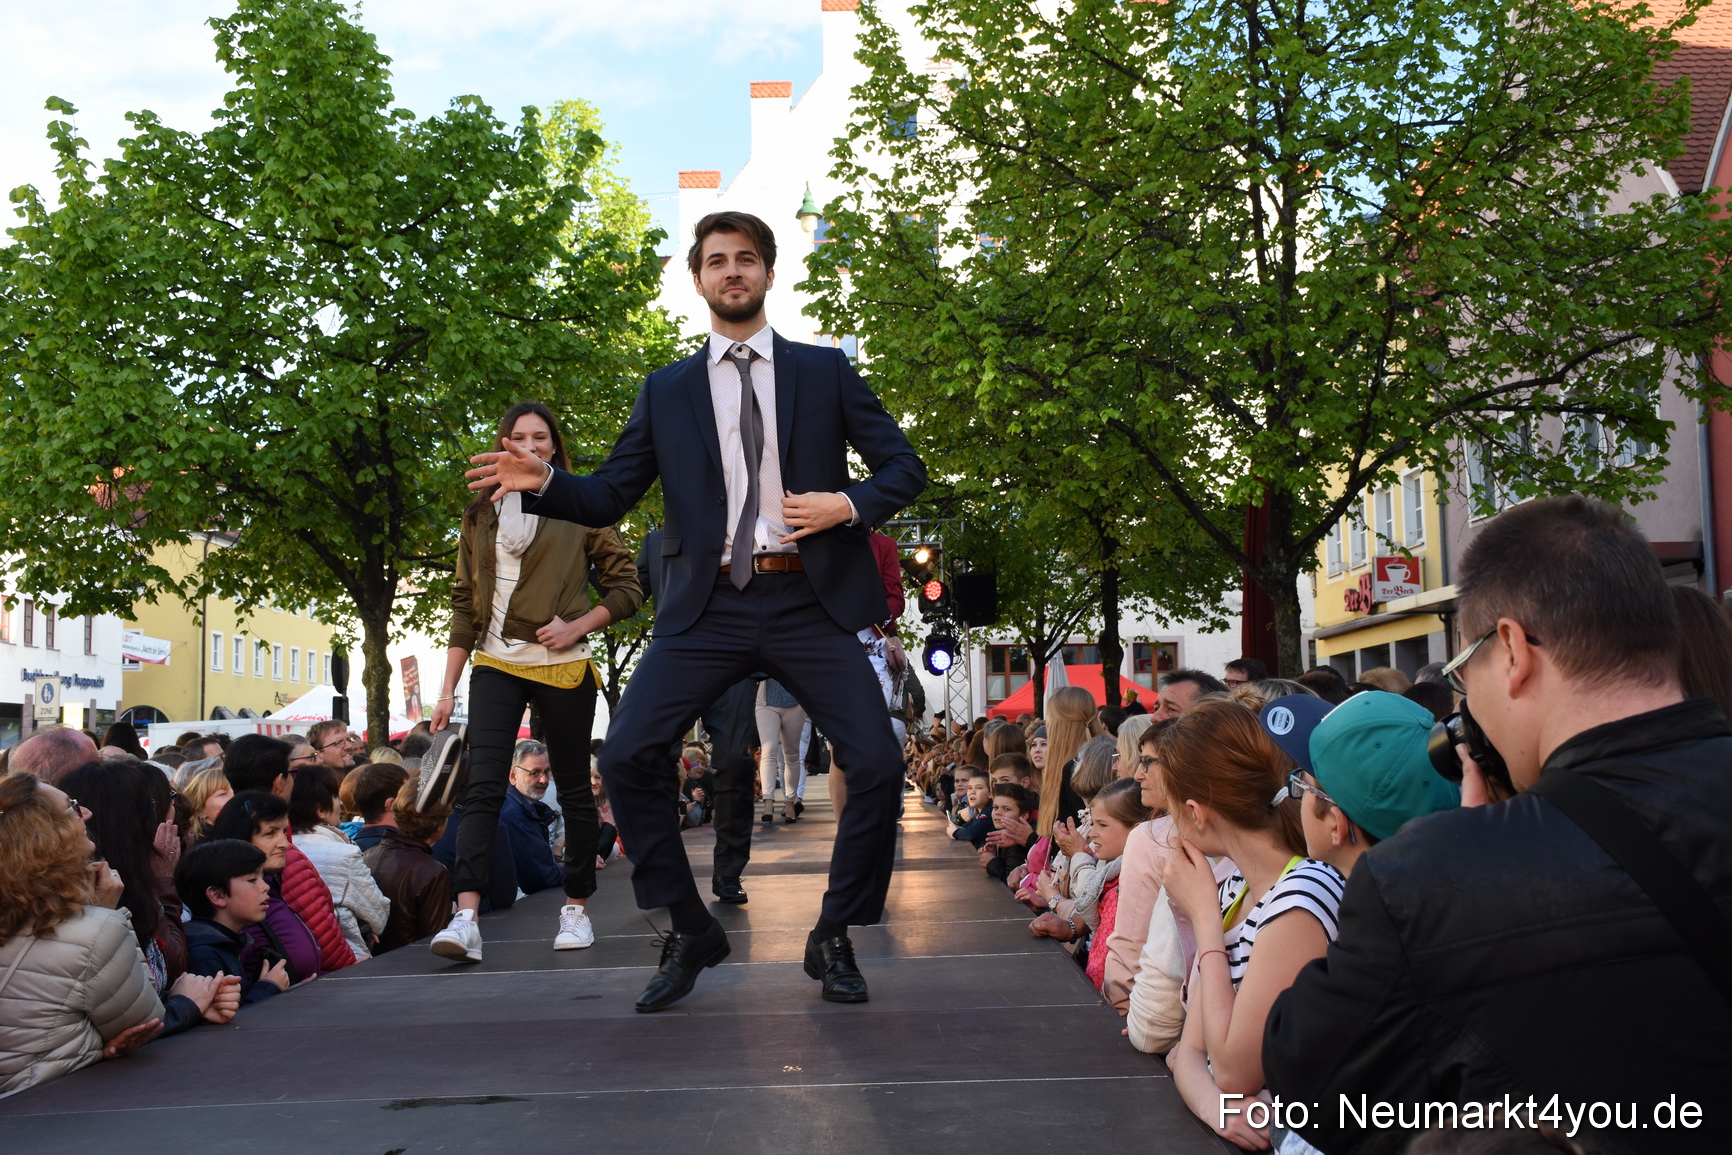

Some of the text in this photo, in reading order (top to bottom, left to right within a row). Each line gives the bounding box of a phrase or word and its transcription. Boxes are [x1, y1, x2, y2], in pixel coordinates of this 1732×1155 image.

[1393, 585, 1414, 597] Beck
[72, 673, 105, 690] Rupprecht
[40, 707, 53, 715] ZONE
